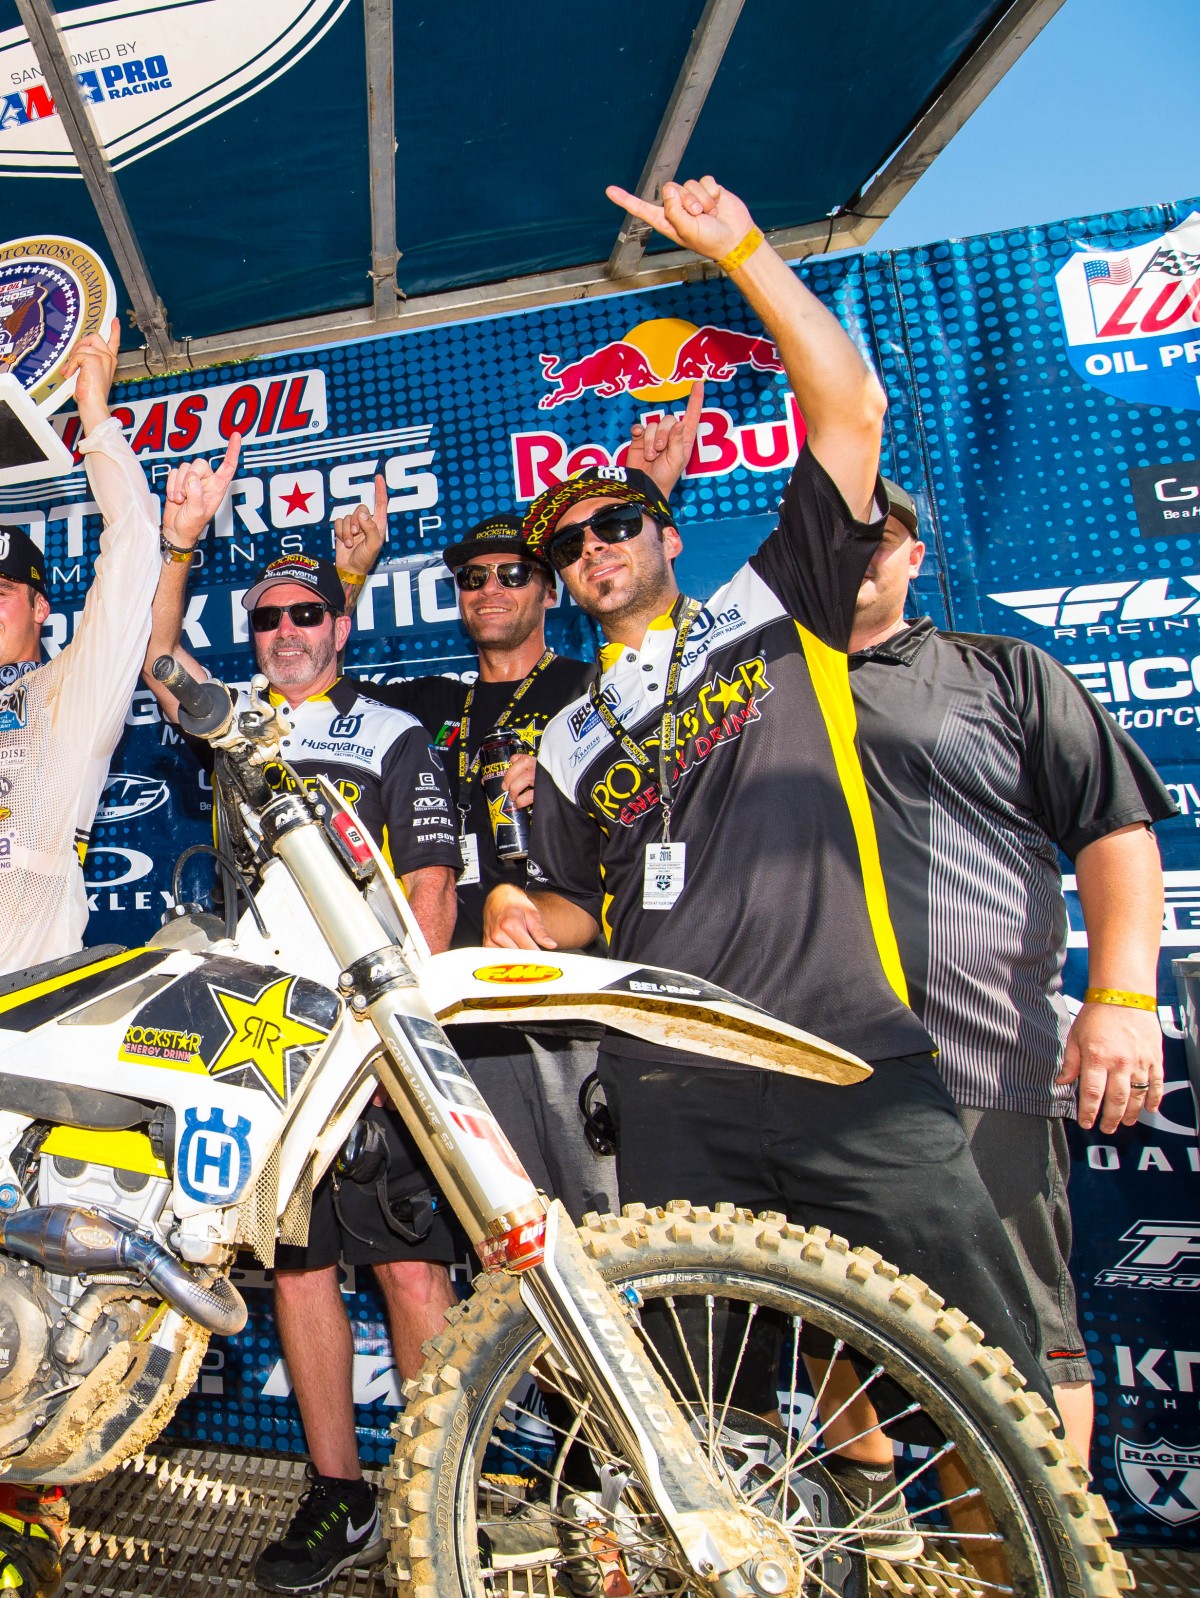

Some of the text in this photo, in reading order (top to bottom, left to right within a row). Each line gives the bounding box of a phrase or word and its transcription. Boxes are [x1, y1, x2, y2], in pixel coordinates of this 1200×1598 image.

[10, 41, 137, 85] SANONED BY
[101, 54, 169, 88] PRO
[108, 77, 173, 99] RACING
[1085, 350, 1148, 376] OIL
[218, 374, 314, 442] OIL
[1163, 508, 1190, 520] Be a
[475, 528, 518, 541] ROCKSTAR
[725, 620, 747, 634] RACING
[1053, 616, 1200, 640] RACIN
[666, 662, 680, 696] ROCKSTAR
[662, 712, 673, 750] ROCKSTAR
[694, 697, 758, 758] DRINK
[301, 738, 375, 758] Husqvarna
[334, 751, 372, 765] FACTORY RACING
[621, 735, 650, 764] ROCKSTAR
[412, 816, 454, 827] EXCEL
[417, 832, 455, 843] HINSON
[659, 850, 672, 862] 2016
[86, 890, 176, 912] KLEY
[485, 965, 561, 981] FMF
[125, 1025, 200, 1053] ROCKSTAR
[125, 1042, 192, 1063] ENERGY DRINK
[676, 1272, 691, 1283] Rim
[577, 1287, 694, 1466] DUNLOP
[435, 1384, 479, 1532] DUNLOP
[1145, 1467, 1199, 1510] X
